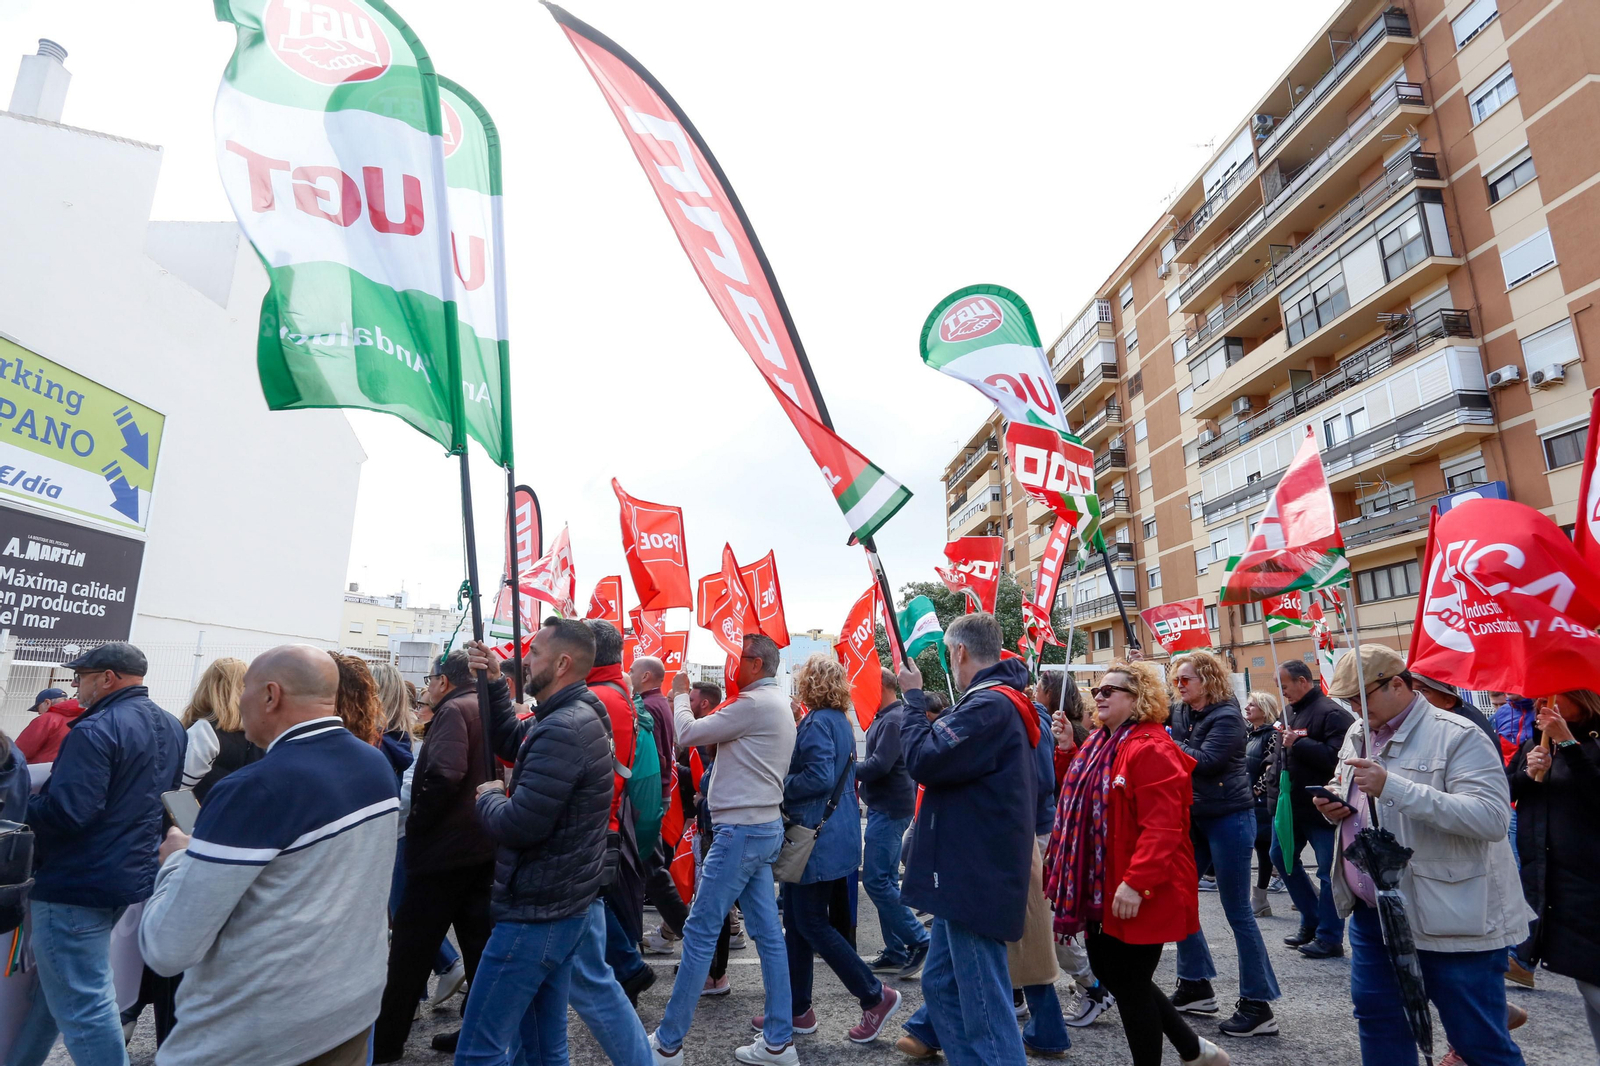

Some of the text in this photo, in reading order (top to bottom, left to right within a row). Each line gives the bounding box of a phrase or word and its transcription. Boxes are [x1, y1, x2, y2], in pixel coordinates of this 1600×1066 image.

[0, 566, 126, 602] Máxima calidad
[20, 593, 106, 617] productos
[0, 606, 60, 629] el mar
[1524, 619, 1540, 638] y
